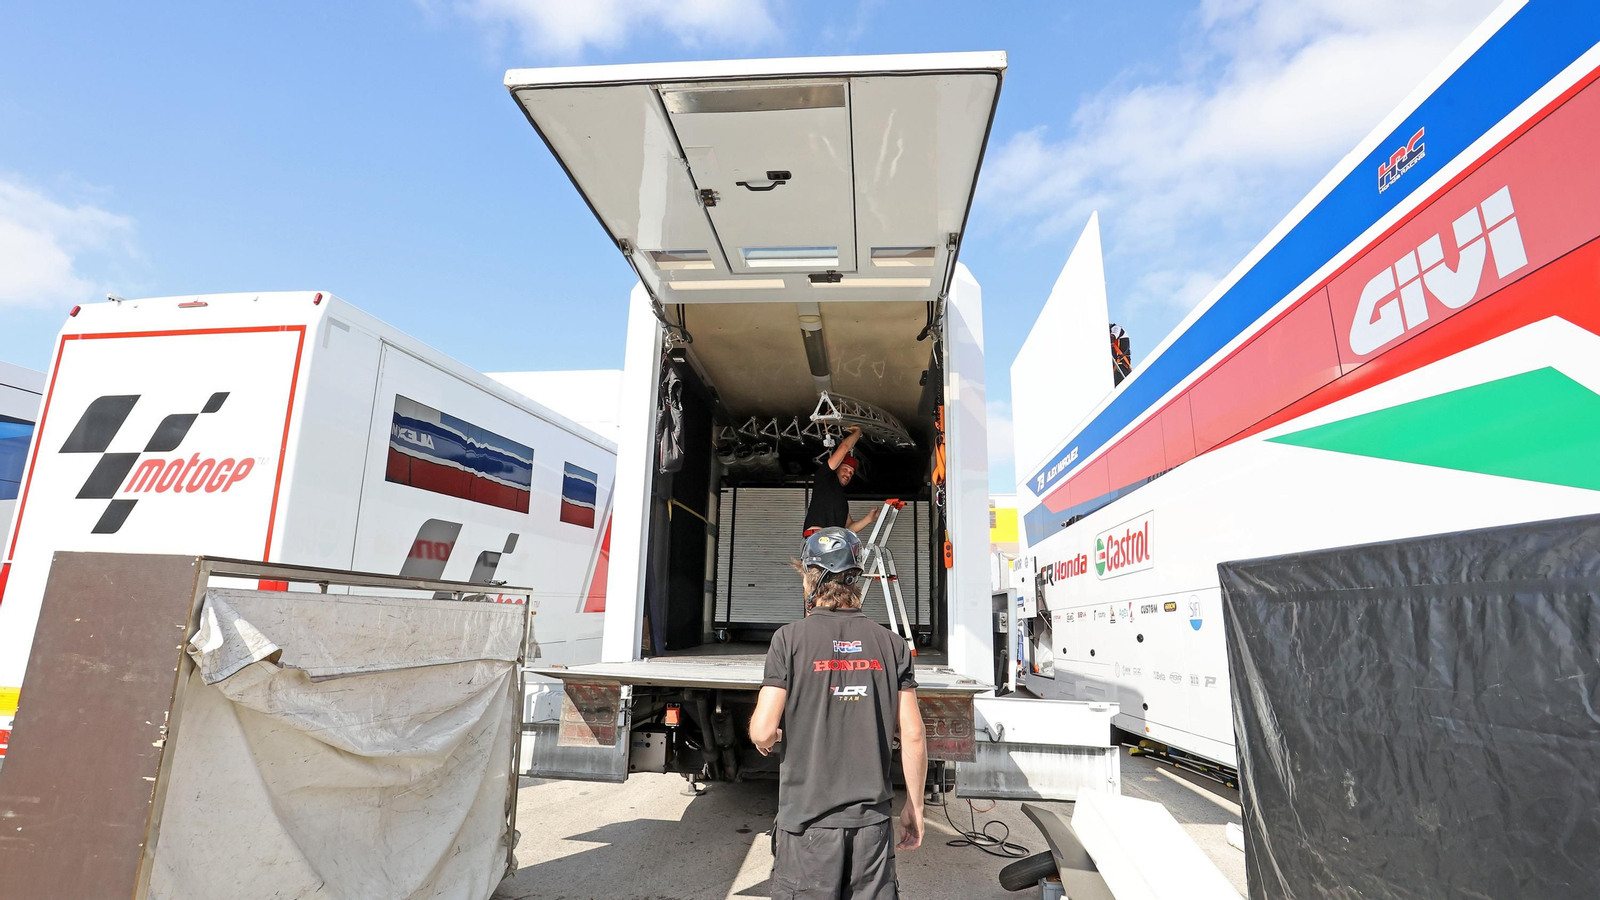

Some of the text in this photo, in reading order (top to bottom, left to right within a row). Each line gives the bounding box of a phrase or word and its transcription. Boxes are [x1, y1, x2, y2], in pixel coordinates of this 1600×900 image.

[1378, 126, 1425, 188] HRC
[1349, 184, 1529, 356] GIVI
[1106, 520, 1150, 572] Castrol
[1054, 553, 1088, 582] Honda
[832, 640, 862, 653] HRC
[812, 658, 883, 672] HONDA
[831, 685, 868, 696] LCR
